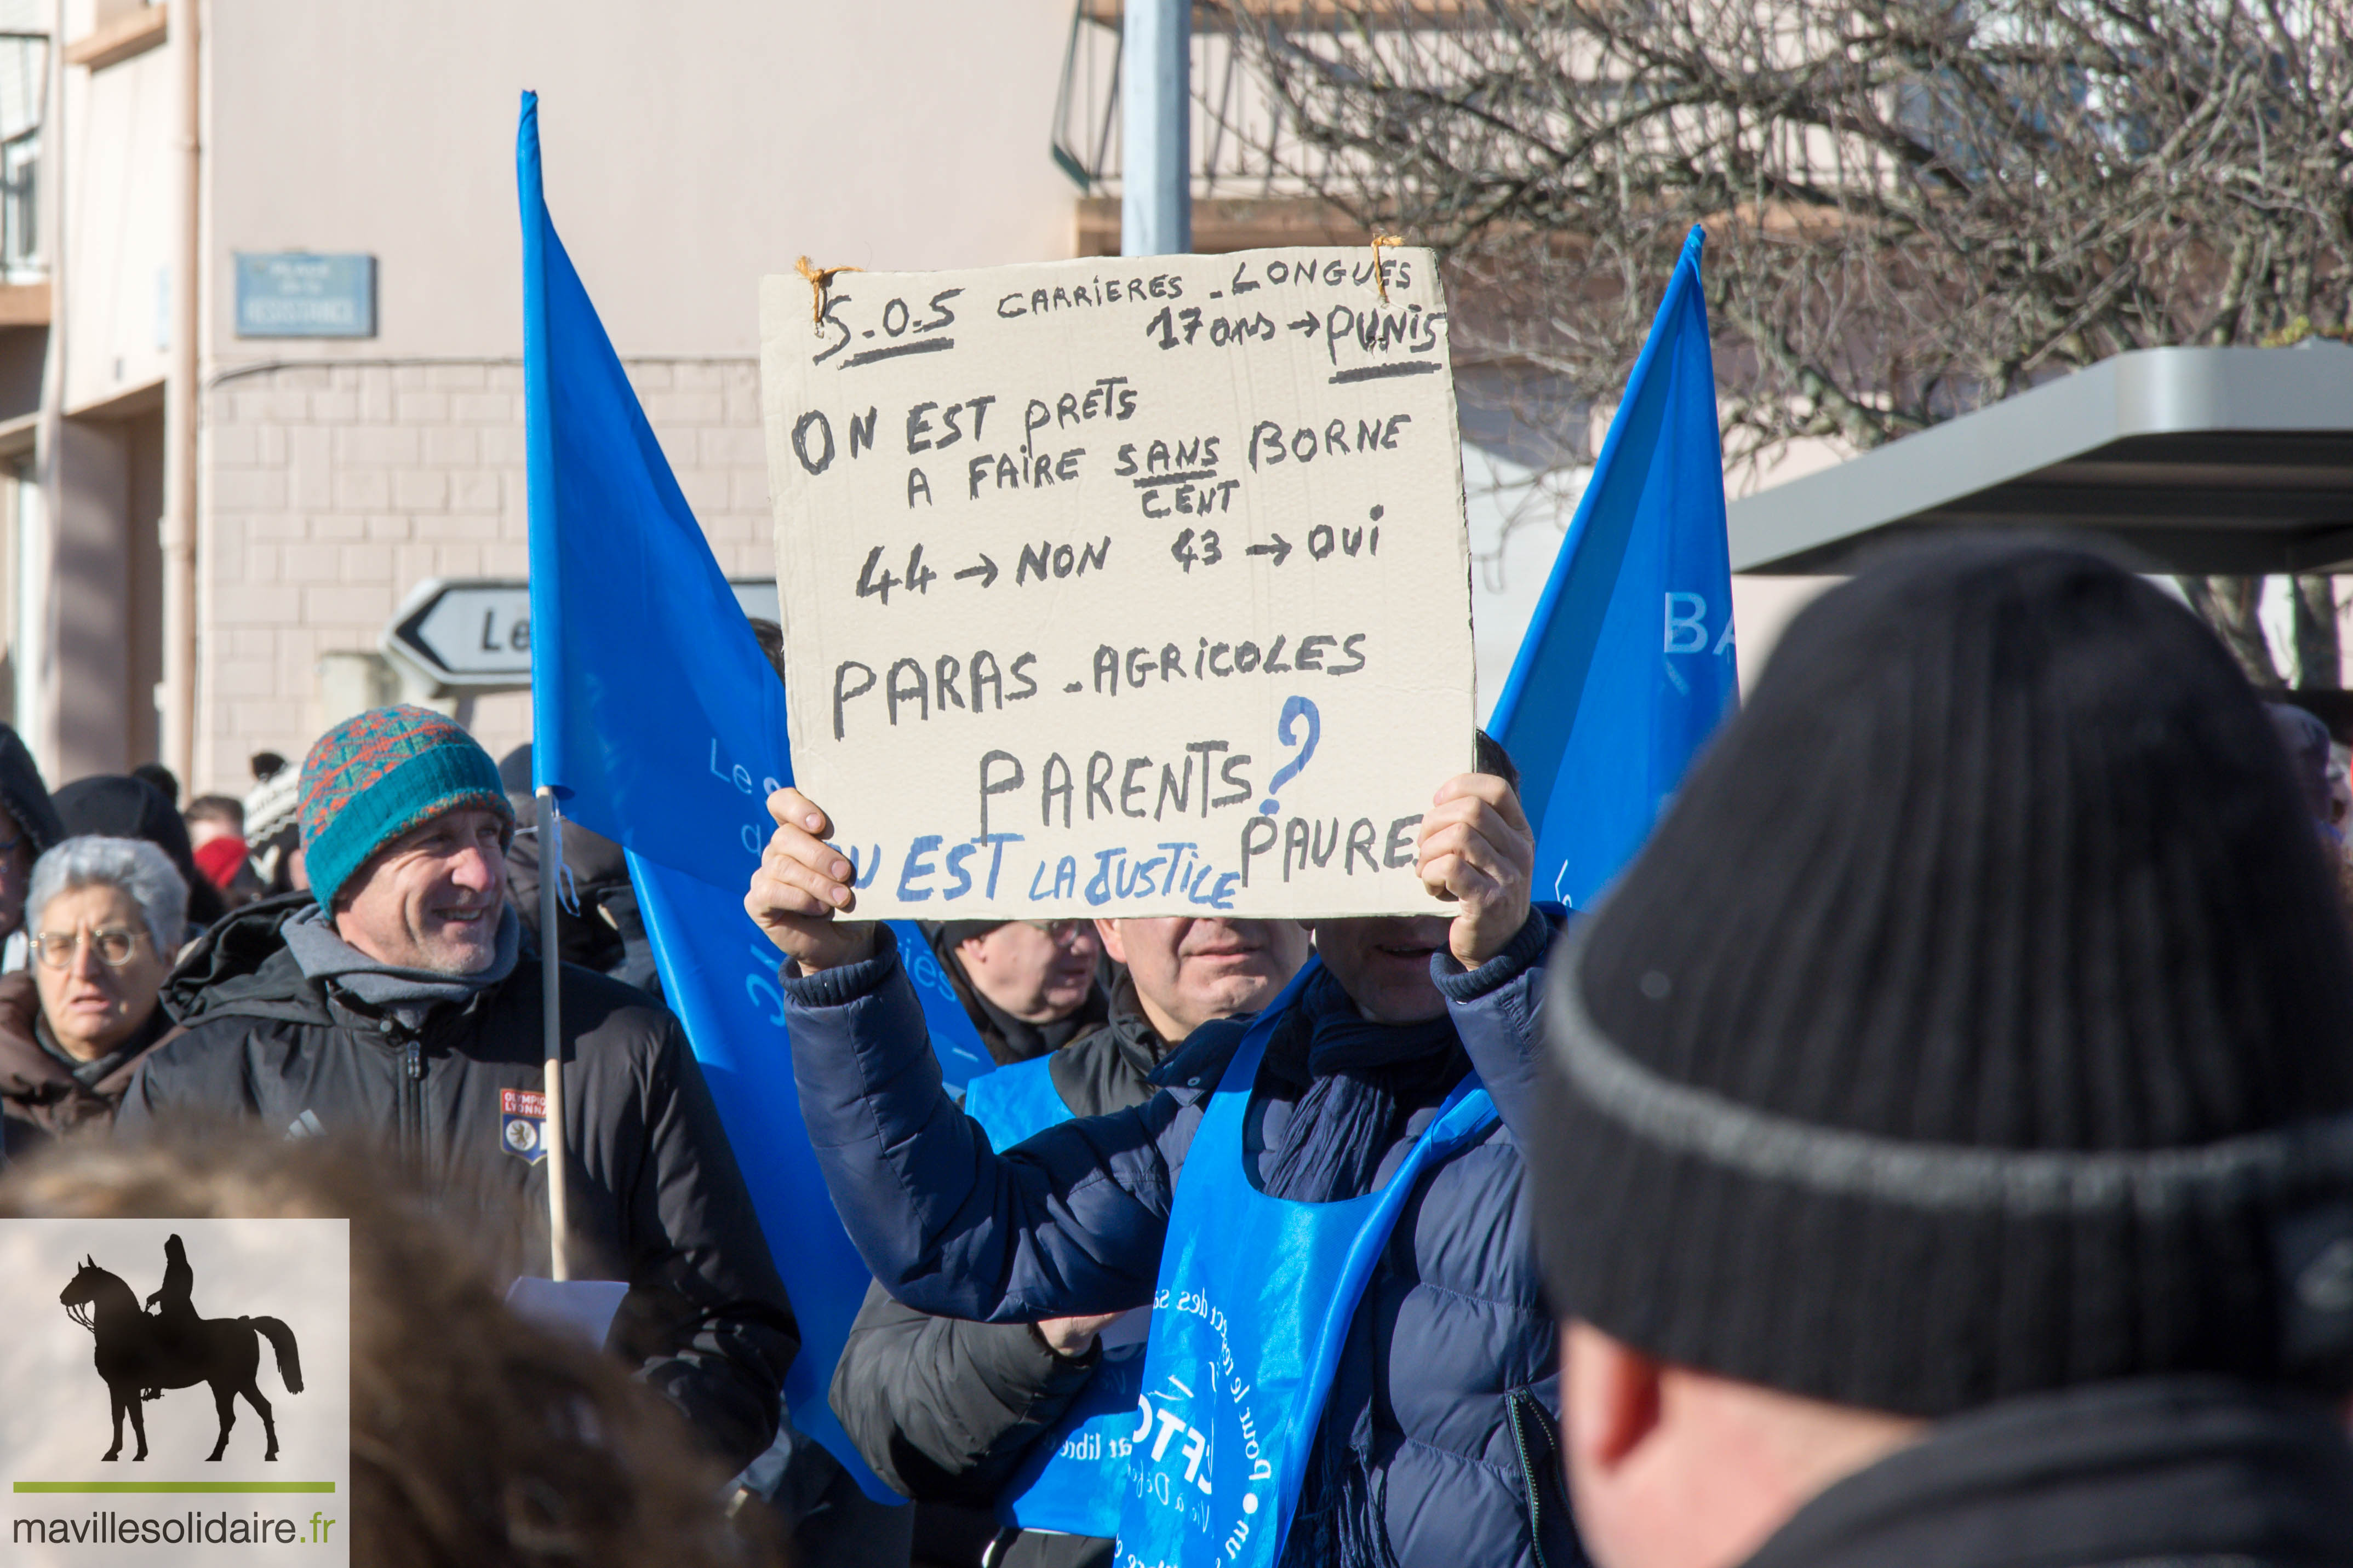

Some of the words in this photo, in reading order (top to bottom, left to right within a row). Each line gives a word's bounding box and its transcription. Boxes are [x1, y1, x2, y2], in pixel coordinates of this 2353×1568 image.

[792, 406, 877, 475] ON
[907, 395, 995, 456] EST
[908, 468, 932, 508] A
[1115, 436, 1220, 476] SANS
[1249, 415, 1411, 473] BORNE
[1141, 479, 1240, 519] CENT
[856, 543, 936, 605] 44
[1016, 536, 1111, 587] NON
[1171, 528, 1222, 573] 43
[834, 650, 1037, 742] PARAS
[980, 740, 1252, 847] PARENTS
[827, 842, 880, 889] U
[897, 834, 1024, 901] EST
[1029, 856, 1076, 901] LA
[1241, 814, 1423, 887] PAURE
